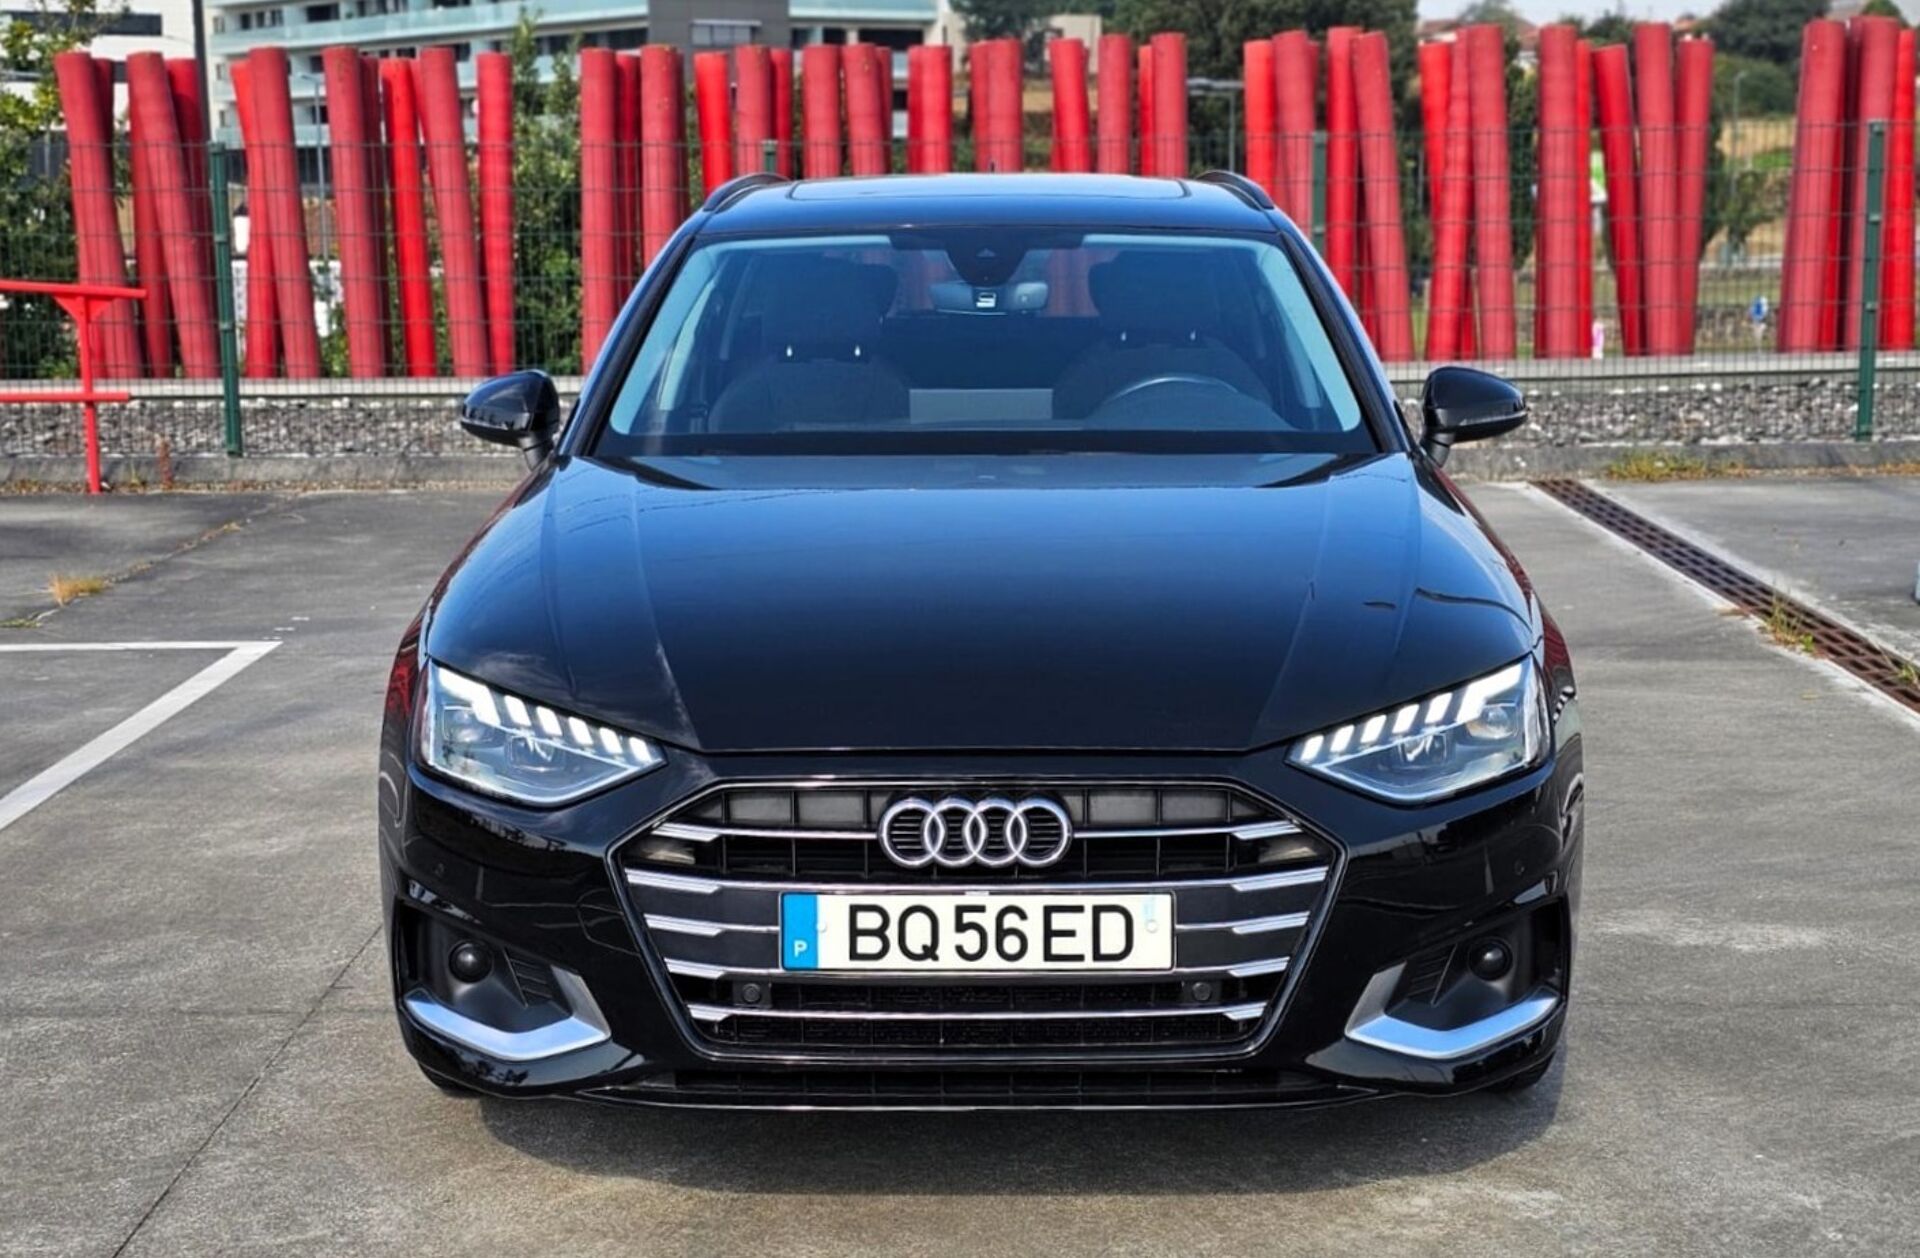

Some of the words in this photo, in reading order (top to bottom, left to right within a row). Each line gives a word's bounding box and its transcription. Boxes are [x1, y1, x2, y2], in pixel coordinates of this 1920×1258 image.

[793, 940, 807, 957] P
[849, 904, 939, 962] BQ
[954, 904, 1028, 962] 56
[1043, 904, 1134, 962] ED
